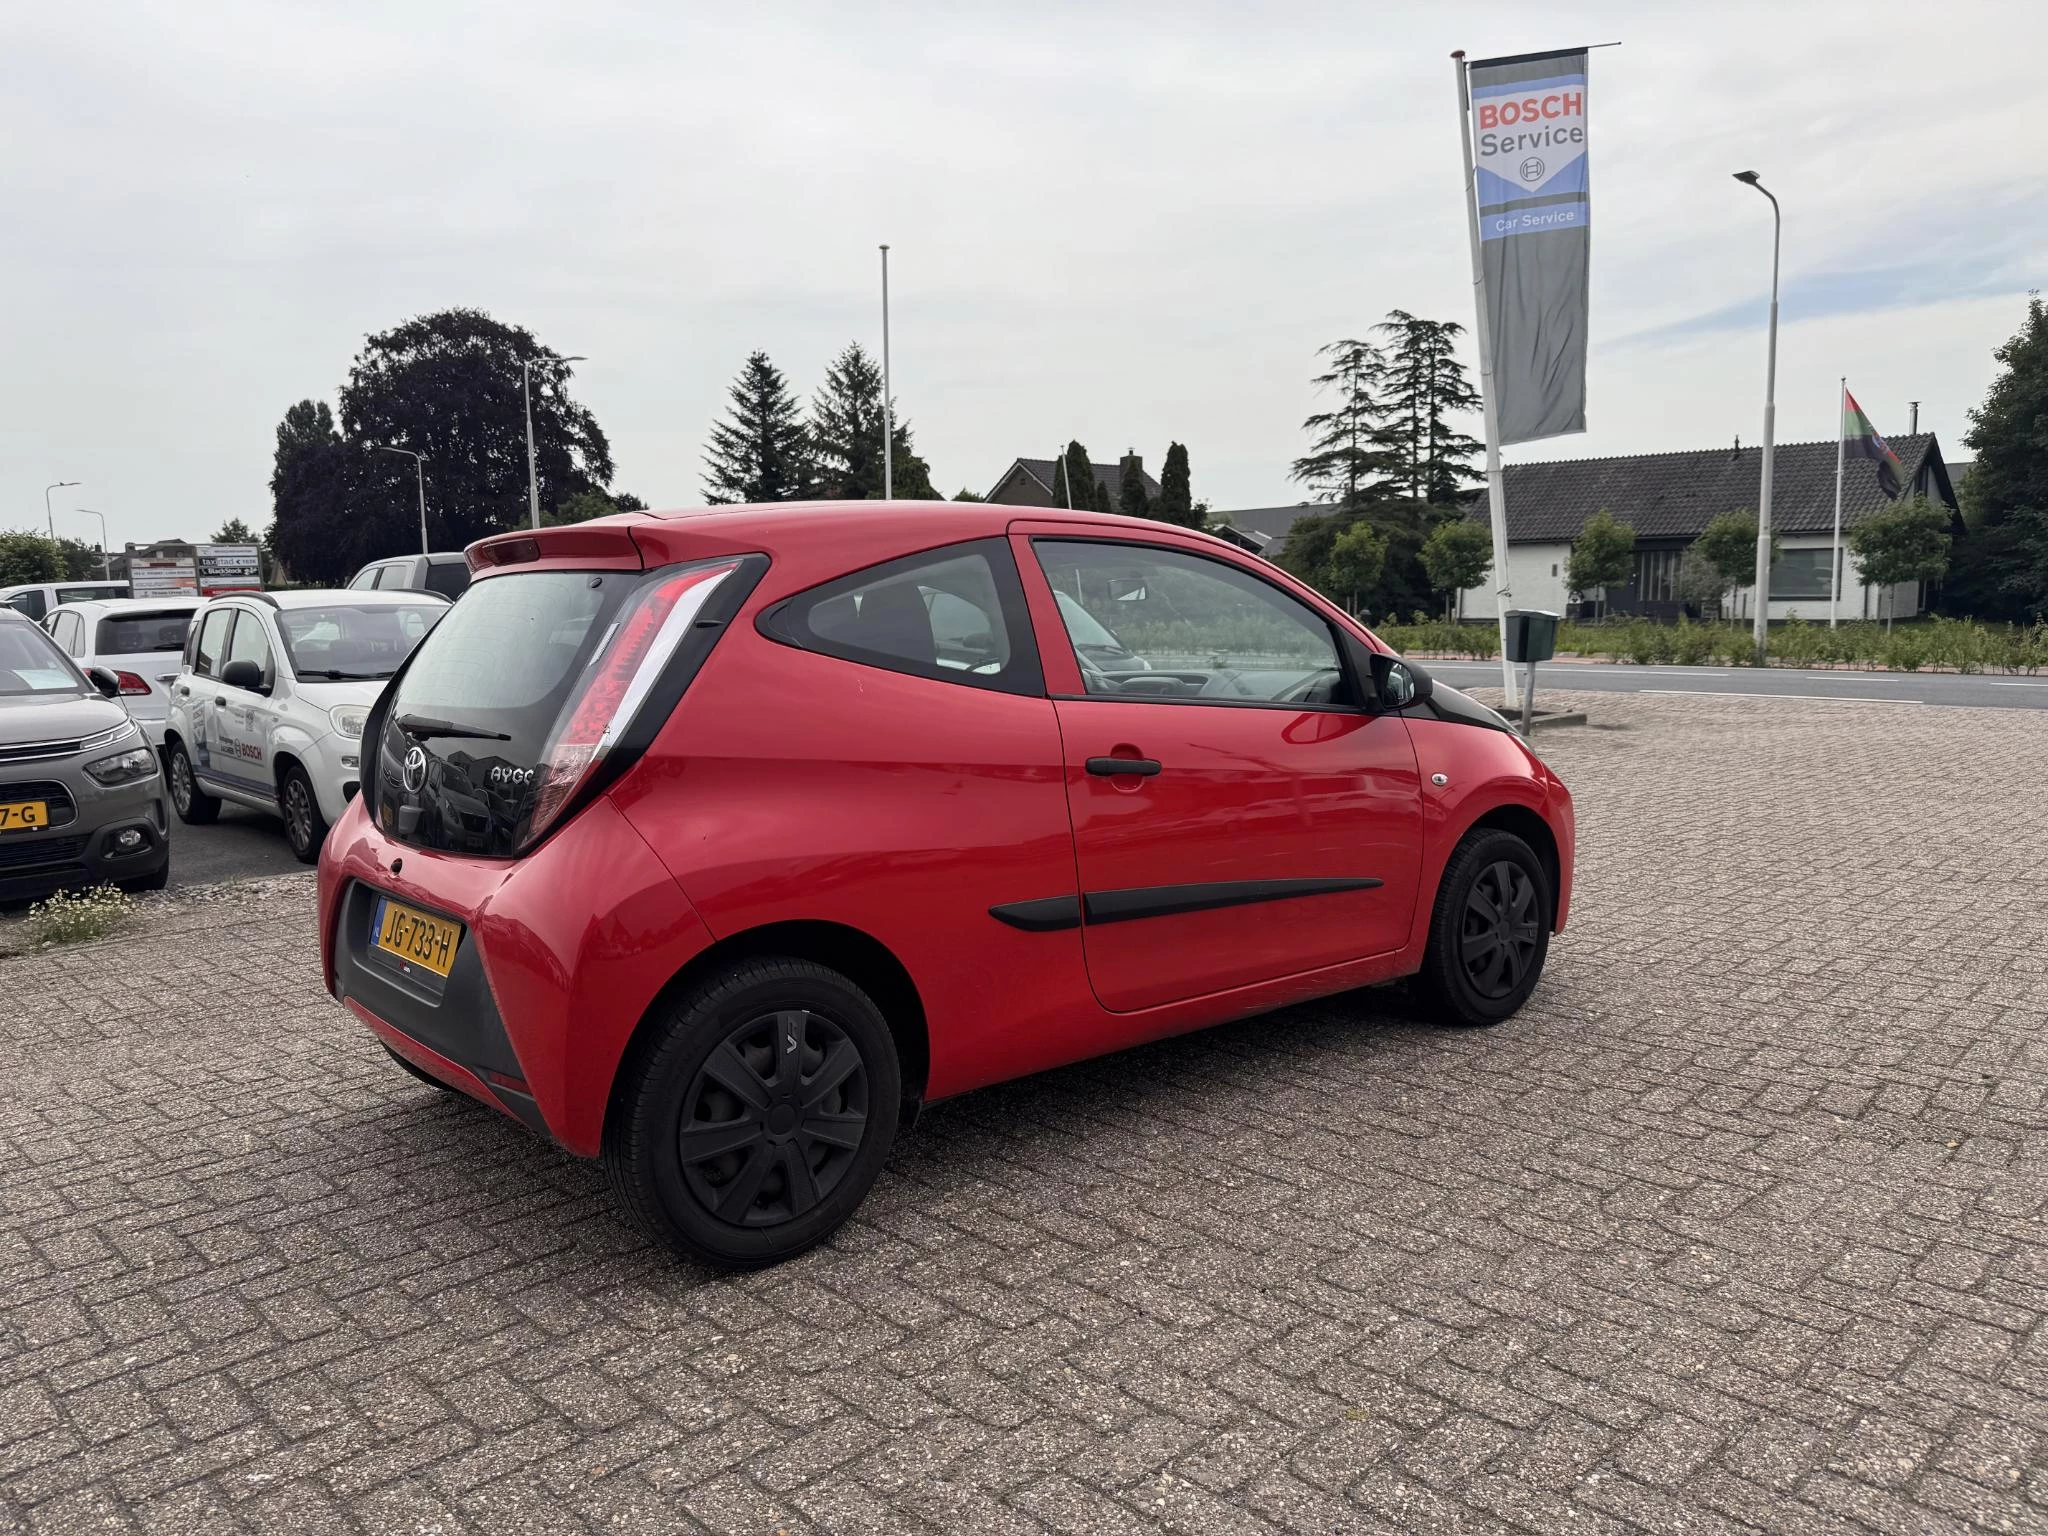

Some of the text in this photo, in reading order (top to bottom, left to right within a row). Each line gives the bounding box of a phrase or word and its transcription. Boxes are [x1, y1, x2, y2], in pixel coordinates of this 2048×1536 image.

[1479, 92, 1582, 129] BOSCH
[1480, 125, 1583, 157] Service
[1495, 211, 1575, 232] Car Service
[241, 743, 263, 760] BOSCH
[0, 805, 36, 826] 7-G
[385, 908, 454, 967] JG-733-H
